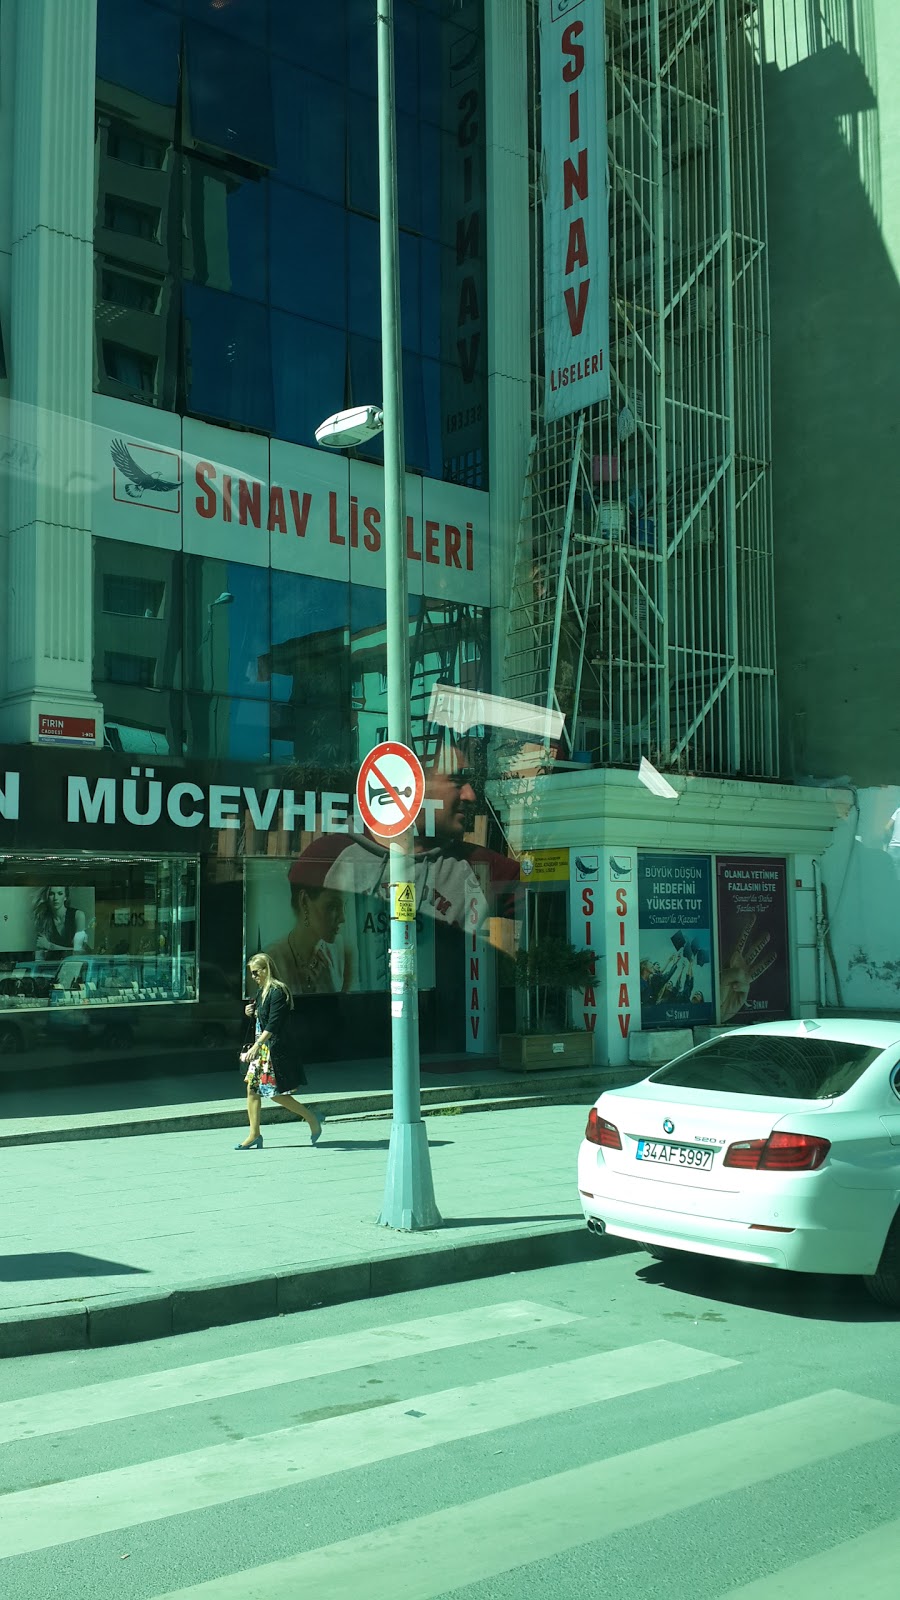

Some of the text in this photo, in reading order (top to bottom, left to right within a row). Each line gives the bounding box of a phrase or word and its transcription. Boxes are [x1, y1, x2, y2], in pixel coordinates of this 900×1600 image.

[561, 20, 590, 337] SINAV
[550, 348, 604, 392] LİSELERİ
[195, 460, 475, 572] SINAV LİSLERİ
[42, 718, 64, 728] FIRIN
[67, 766, 444, 838] MÜCEVHET
[645, 865, 702, 879] BÜYÜK DÜŞÜN
[724, 868, 779, 880] OLANLA YETİNME
[728, 881, 776, 892] FAZLASINI İSTE
[653, 880, 696, 894] HEDEFİNİ
[646, 895, 702, 910] YÜKSEK TUT
[470, 897, 479, 1039] SINAV
[616, 887, 631, 1038] SINAV
